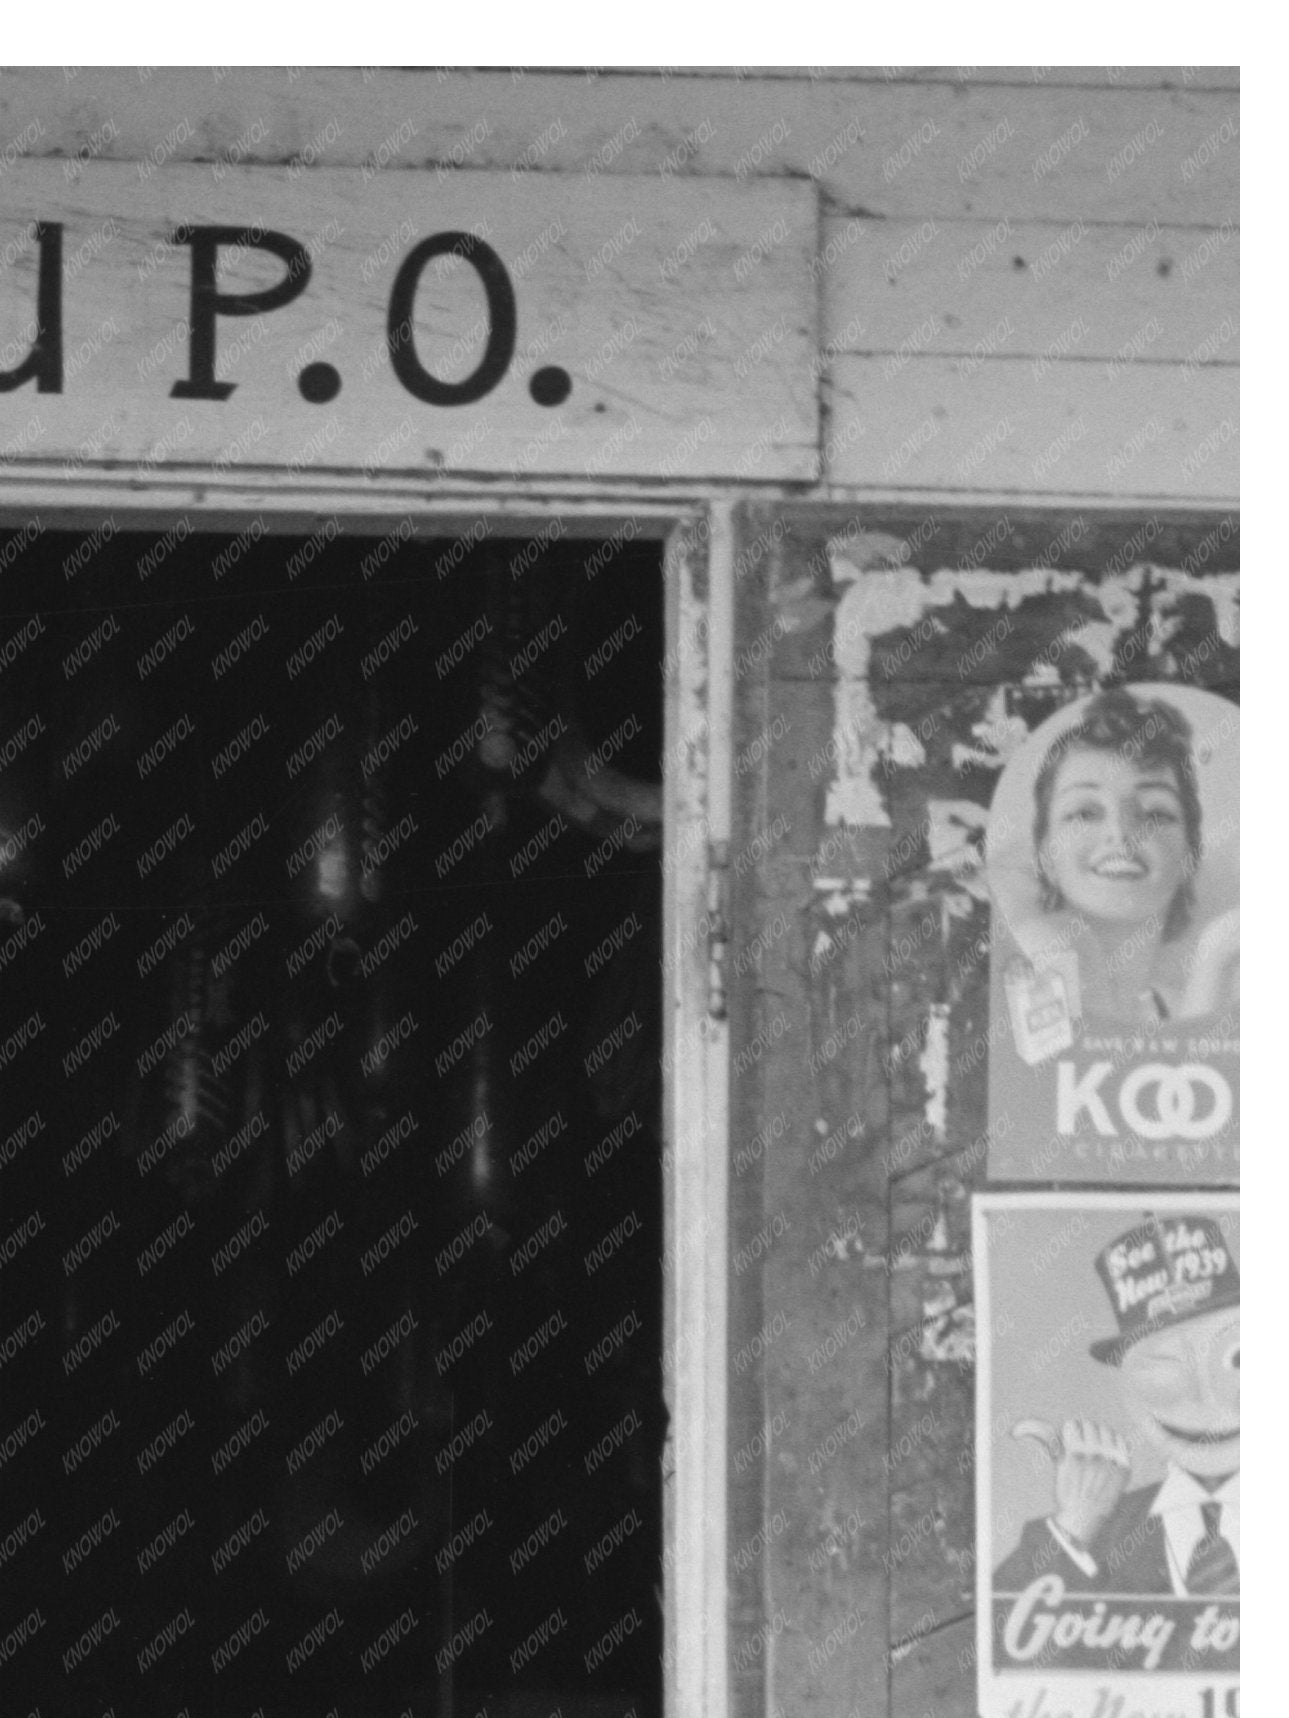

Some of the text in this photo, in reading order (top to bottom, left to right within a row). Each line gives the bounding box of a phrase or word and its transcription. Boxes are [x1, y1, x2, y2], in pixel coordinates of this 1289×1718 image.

[168, 224, 572, 406] P.O.
[1058, 1061, 1232, 1139] KOO
[1004, 1573, 1239, 1670] Going to
